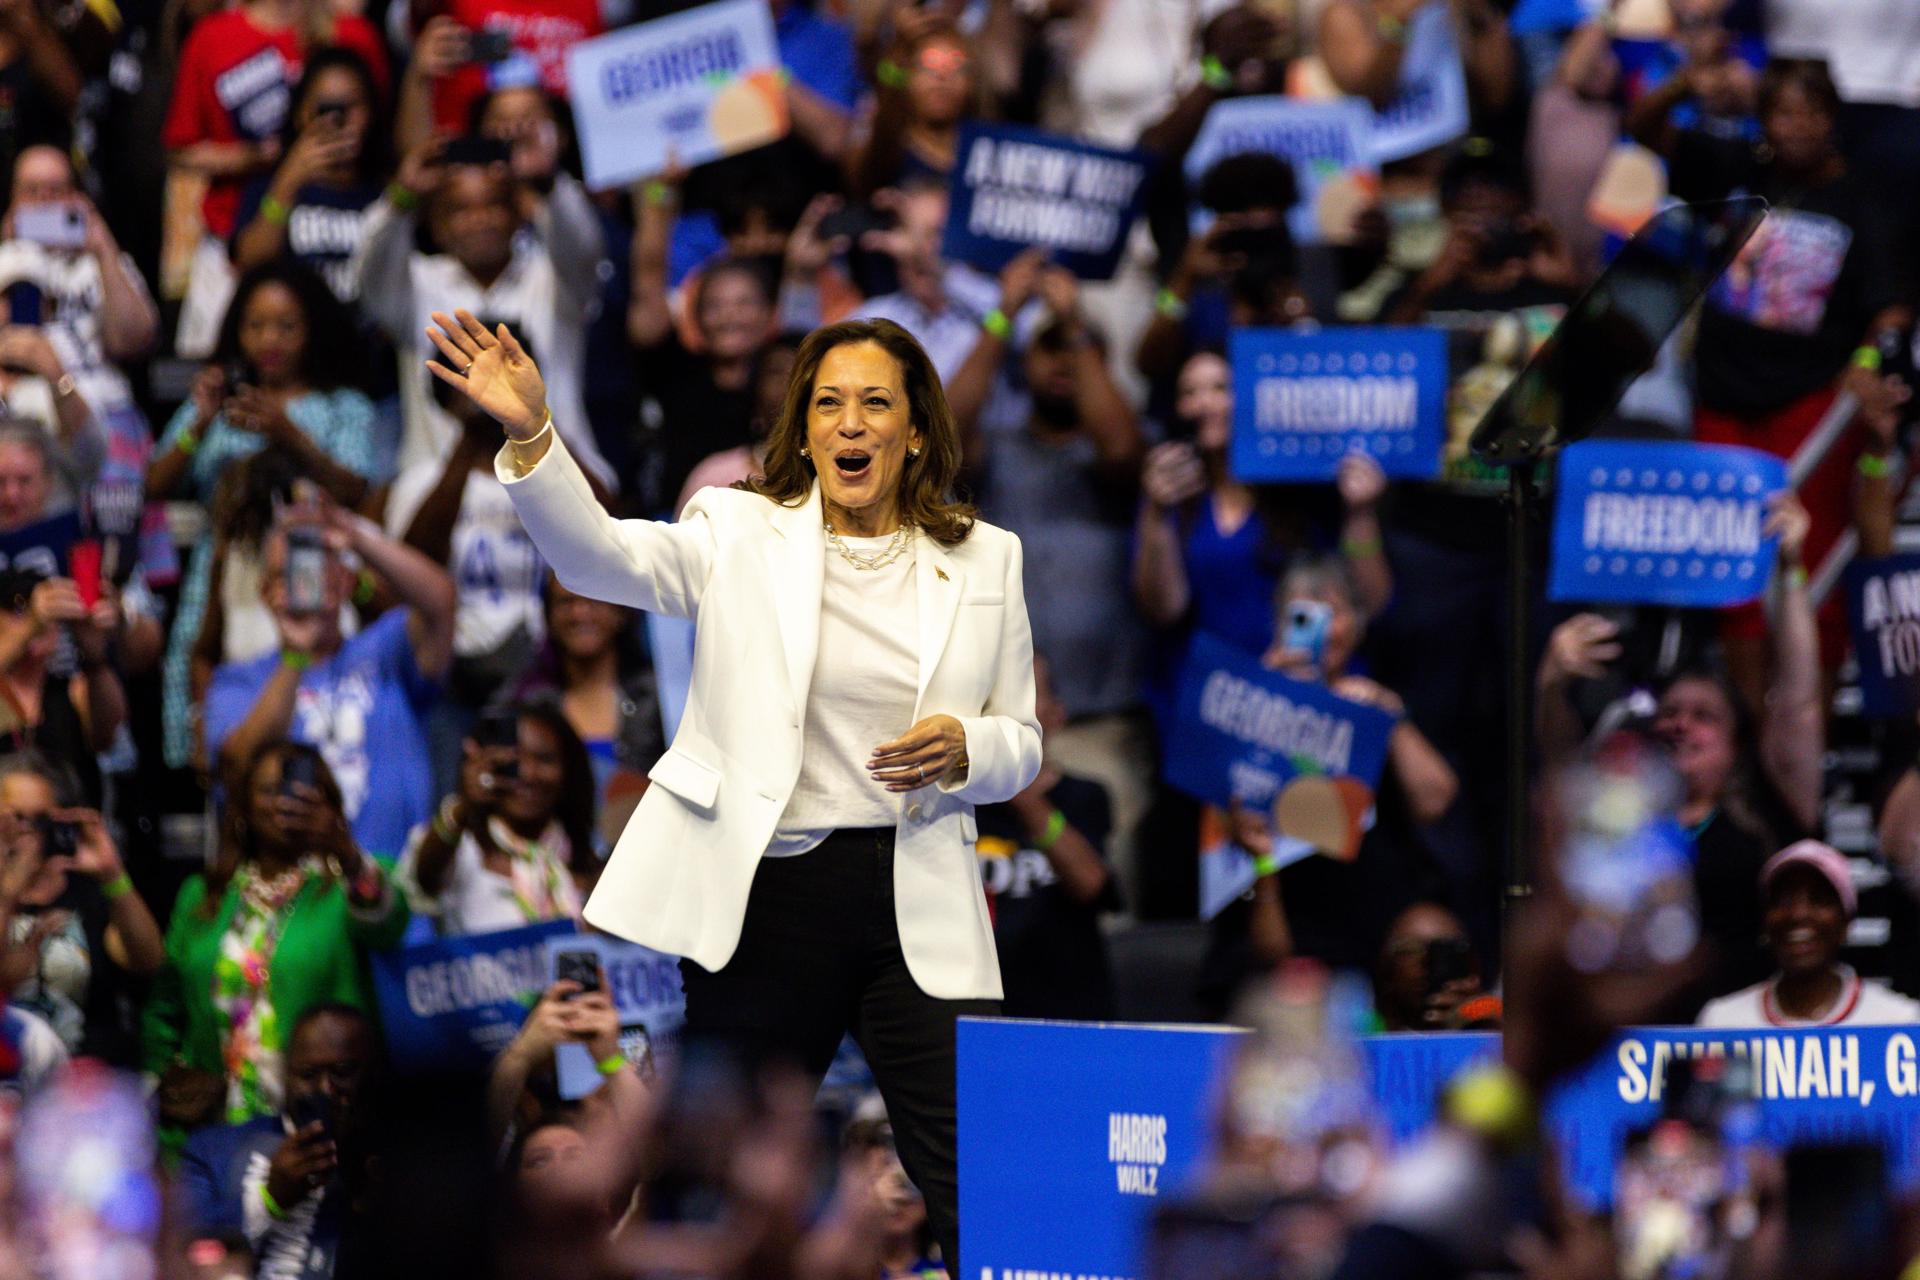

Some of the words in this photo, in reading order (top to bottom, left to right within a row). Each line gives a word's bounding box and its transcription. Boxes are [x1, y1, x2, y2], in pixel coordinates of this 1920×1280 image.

[1255, 375, 1419, 433] FREEDOM
[1583, 491, 1760, 556] FREEDOM
[1200, 669, 1354, 774] GEORGIA
[1618, 1034, 1876, 1107] SANNAH,
[1885, 1032, 1920, 1098] G
[1108, 1112, 1167, 1166] HARRIS
[1116, 1164, 1159, 1196] WALZ
